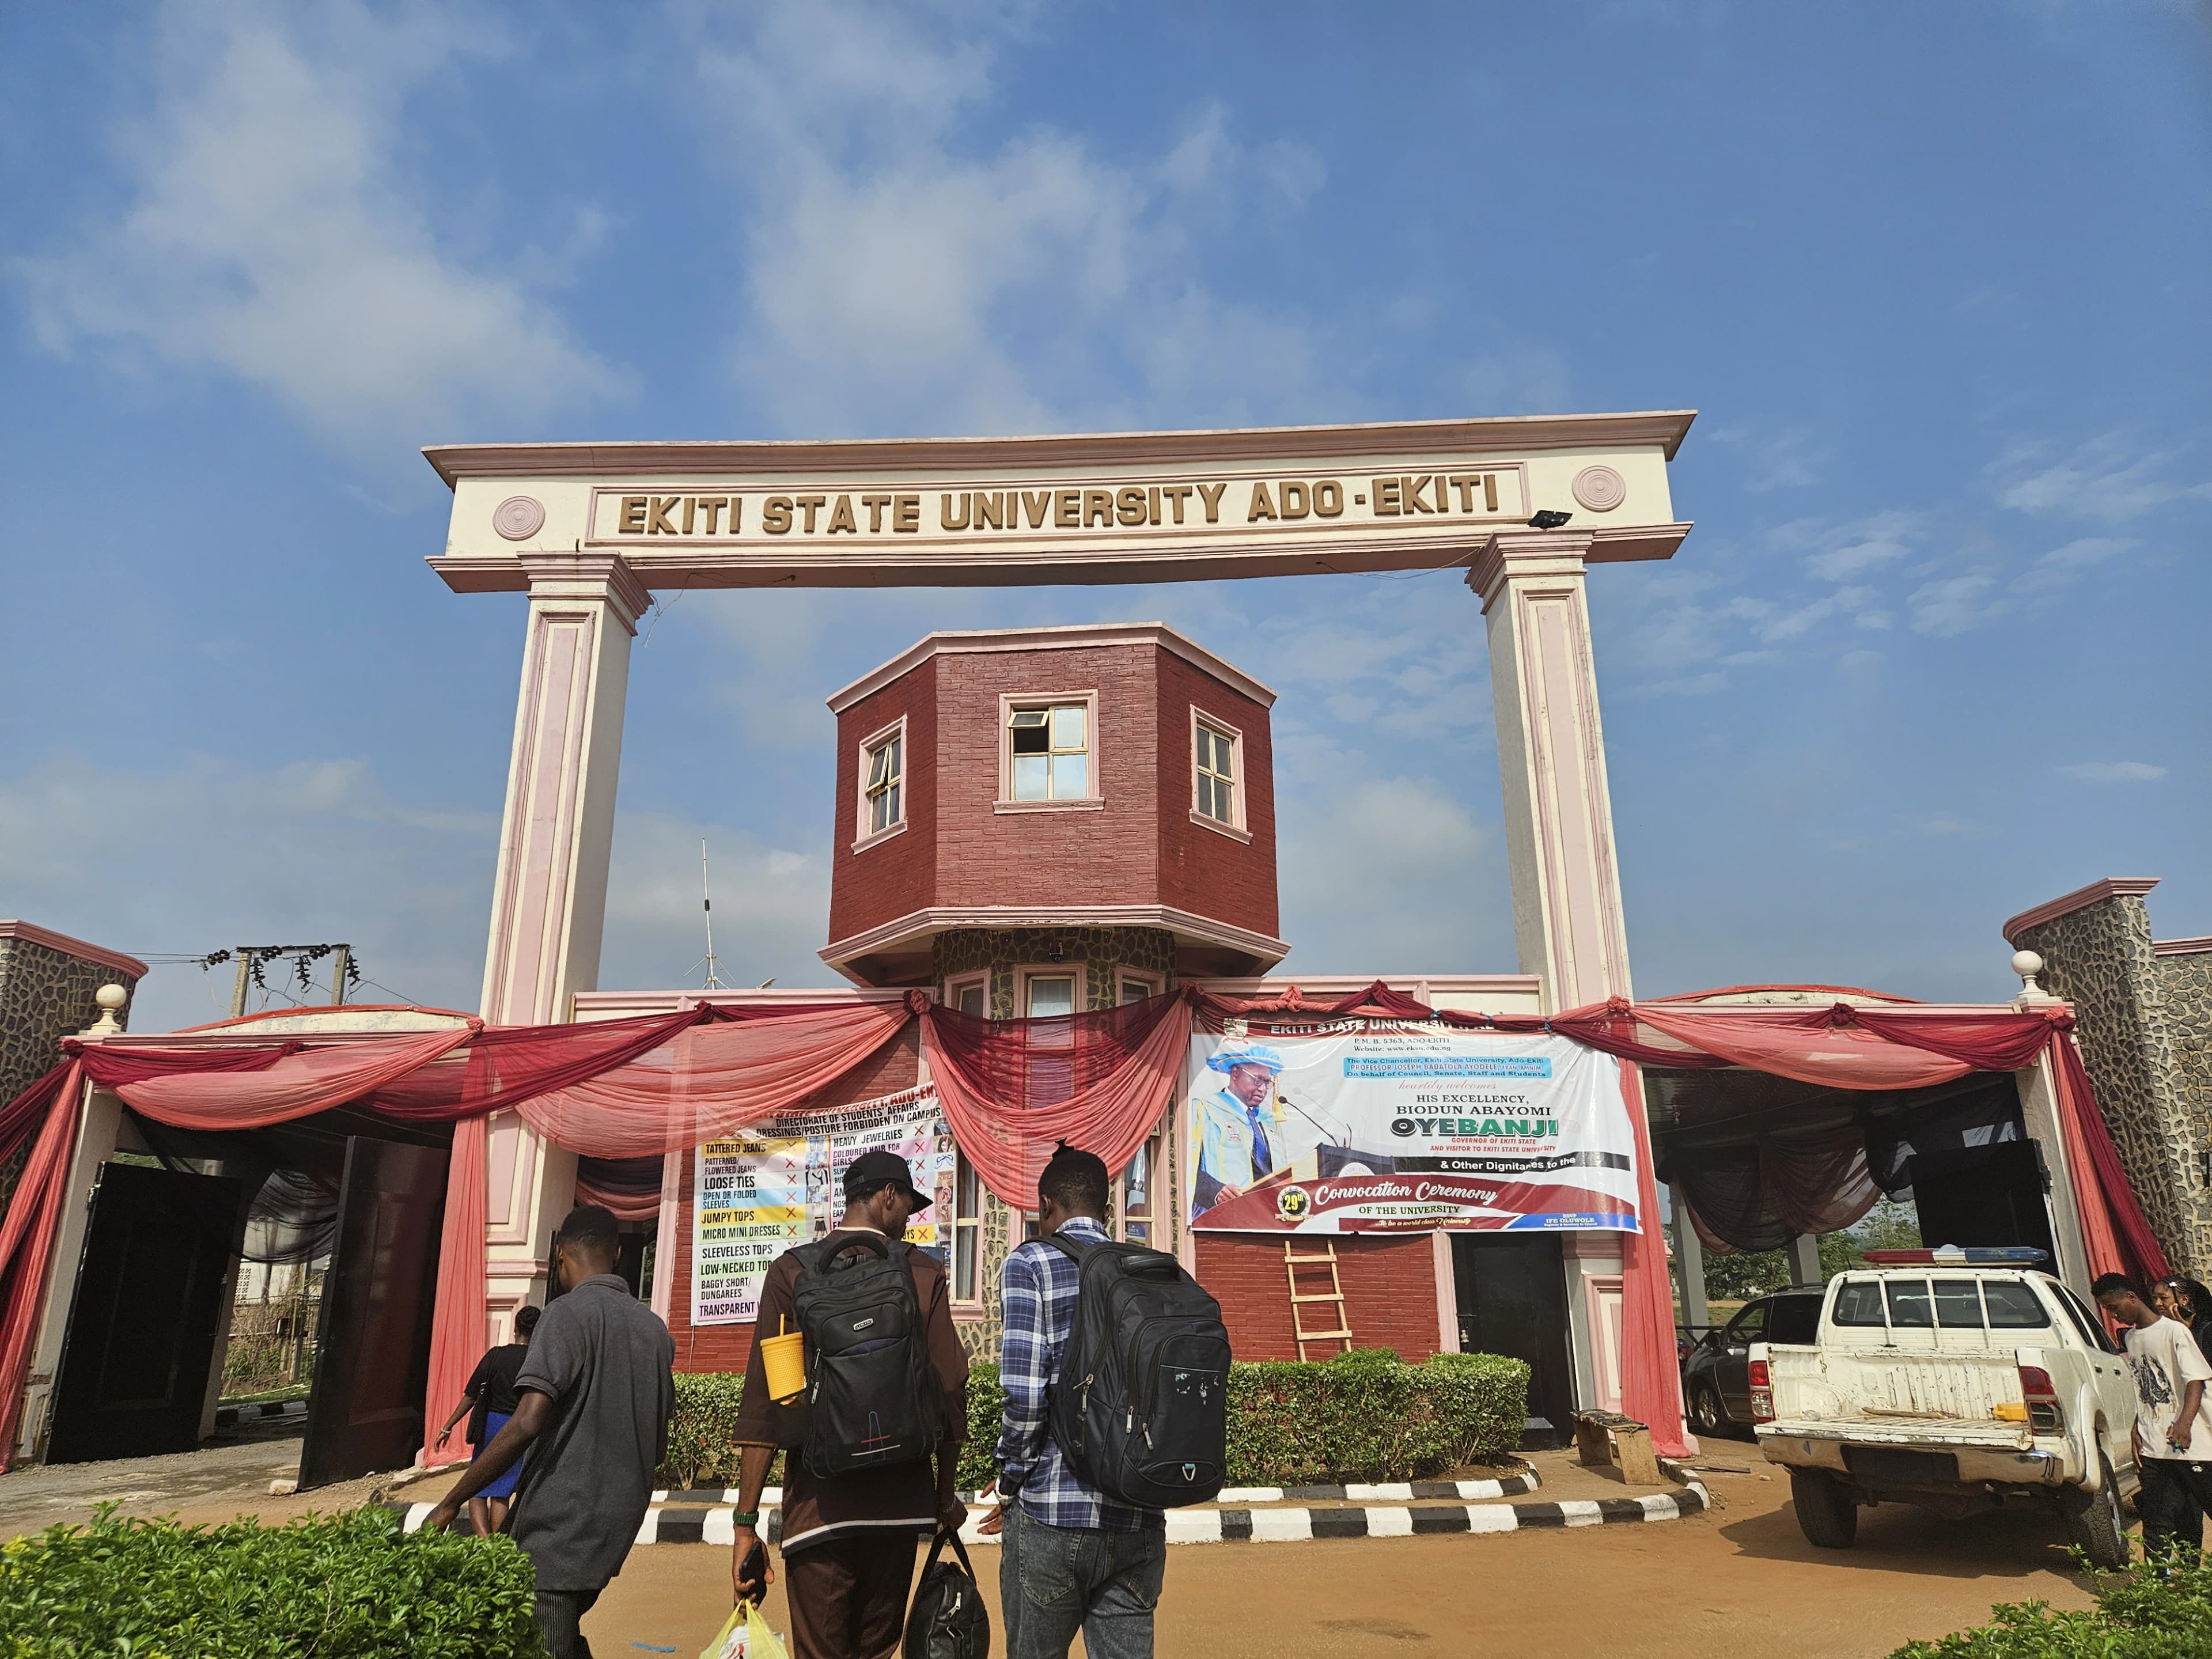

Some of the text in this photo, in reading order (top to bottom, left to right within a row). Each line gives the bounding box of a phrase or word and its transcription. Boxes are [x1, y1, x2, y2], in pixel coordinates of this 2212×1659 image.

[619, 497, 741, 533] EKITI
[763, 495, 920, 533] STATE
[941, 483, 1226, 531] UNIVERSITY
[1271, 1025, 1312, 1034] EKITI
[1317, 1019, 1365, 1032] STATE
[1398, 1079, 1443, 1093] heartily
[1442, 1094, 1529, 1105] EXCELLENCY,
[777, 1101, 919, 1127] DIRECTORATE OF STUDENTS' AFFAIRS
[1396, 1105, 1551, 1116] BIODUN ABAYOMI
[756, 1108, 941, 1138] DRESSINGS/POSTURE FORBIDDEN ON CAMPUS
[1390, 1118, 1558, 1137] OYEBANJI
[834, 1129, 903, 1147] HEAVY JEWELRIES
[706, 1143, 767, 1154] TATTERED JEANS
[833, 1143, 900, 1158] COLOURED HAIR FOR
[705, 1157, 740, 1165] PATTERNED/
[833, 1157, 853, 1166] GIRLS
[1440, 1161, 1449, 1169] &
[1452, 1161, 1483, 1170] Other
[1547, 1161, 1558, 1169] to
[1560, 1157, 1575, 1166] the
[704, 1165, 756, 1175] FLOWERED JEANS
[704, 1176, 755, 1190] LOOSE TIES
[703, 1190, 757, 1201] OPEN OR FOLDED
[1315, 1180, 1498, 1206] Convocation Ceremony
[703, 1200, 730, 1210] SLEEVES
[1284, 1194, 1304, 1210] 29th
[1359, 1205, 1460, 1215] OF THE UNIVERSITY
[702, 1211, 755, 1224] JUMPY TOPS
[702, 1225, 781, 1240] MICRO MINI DRESSES
[702, 1244, 773, 1259] SLEEVELESS TOPS
[700, 1260, 774, 1275] LOW-NECKED TOP
[701, 1277, 752, 1289] BAGGY SHORT/
[701, 1289, 743, 1300] DUNGAREES
[699, 1302, 755, 1317] TRANSPARENT
